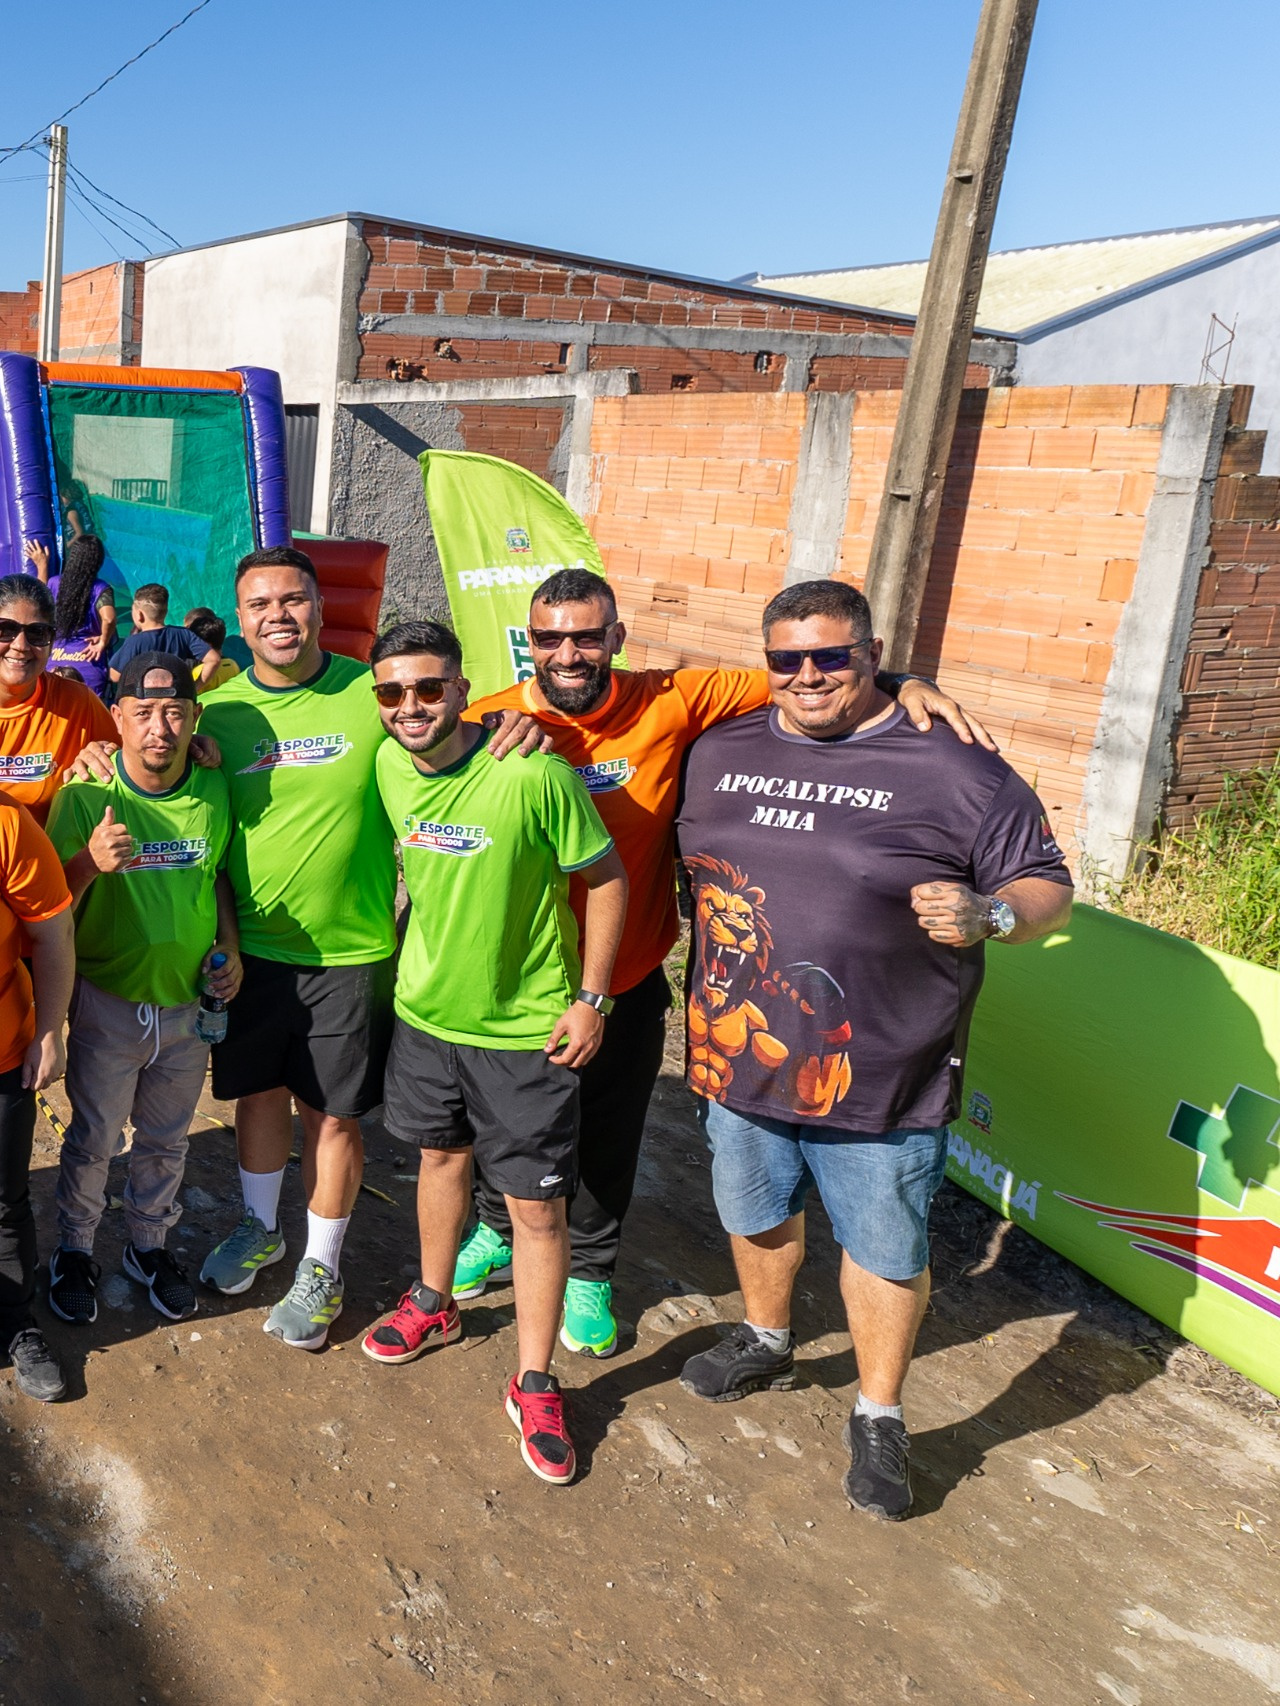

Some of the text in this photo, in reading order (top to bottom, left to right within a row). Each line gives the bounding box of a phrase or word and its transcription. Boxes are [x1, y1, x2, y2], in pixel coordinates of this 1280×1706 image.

[458, 558, 586, 591] PARANAG
[51, 647, 87, 662] Monito
[273, 734, 344, 752] ESPORTE
[271, 749, 325, 761] PARA TODOS
[8, 767, 35, 775] TODOS
[585, 776, 609, 786] ODOS
[714, 773, 893, 812] APOCALYPSE
[749, 805, 815, 832] MMA
[420, 822, 483, 838] ESPORTE
[142, 839, 205, 853] ESPORTE
[417, 834, 463, 847] PARA TODOS
[164, 853, 188, 861] TODOS
[947, 1126, 1043, 1221] ANAGUÁ
